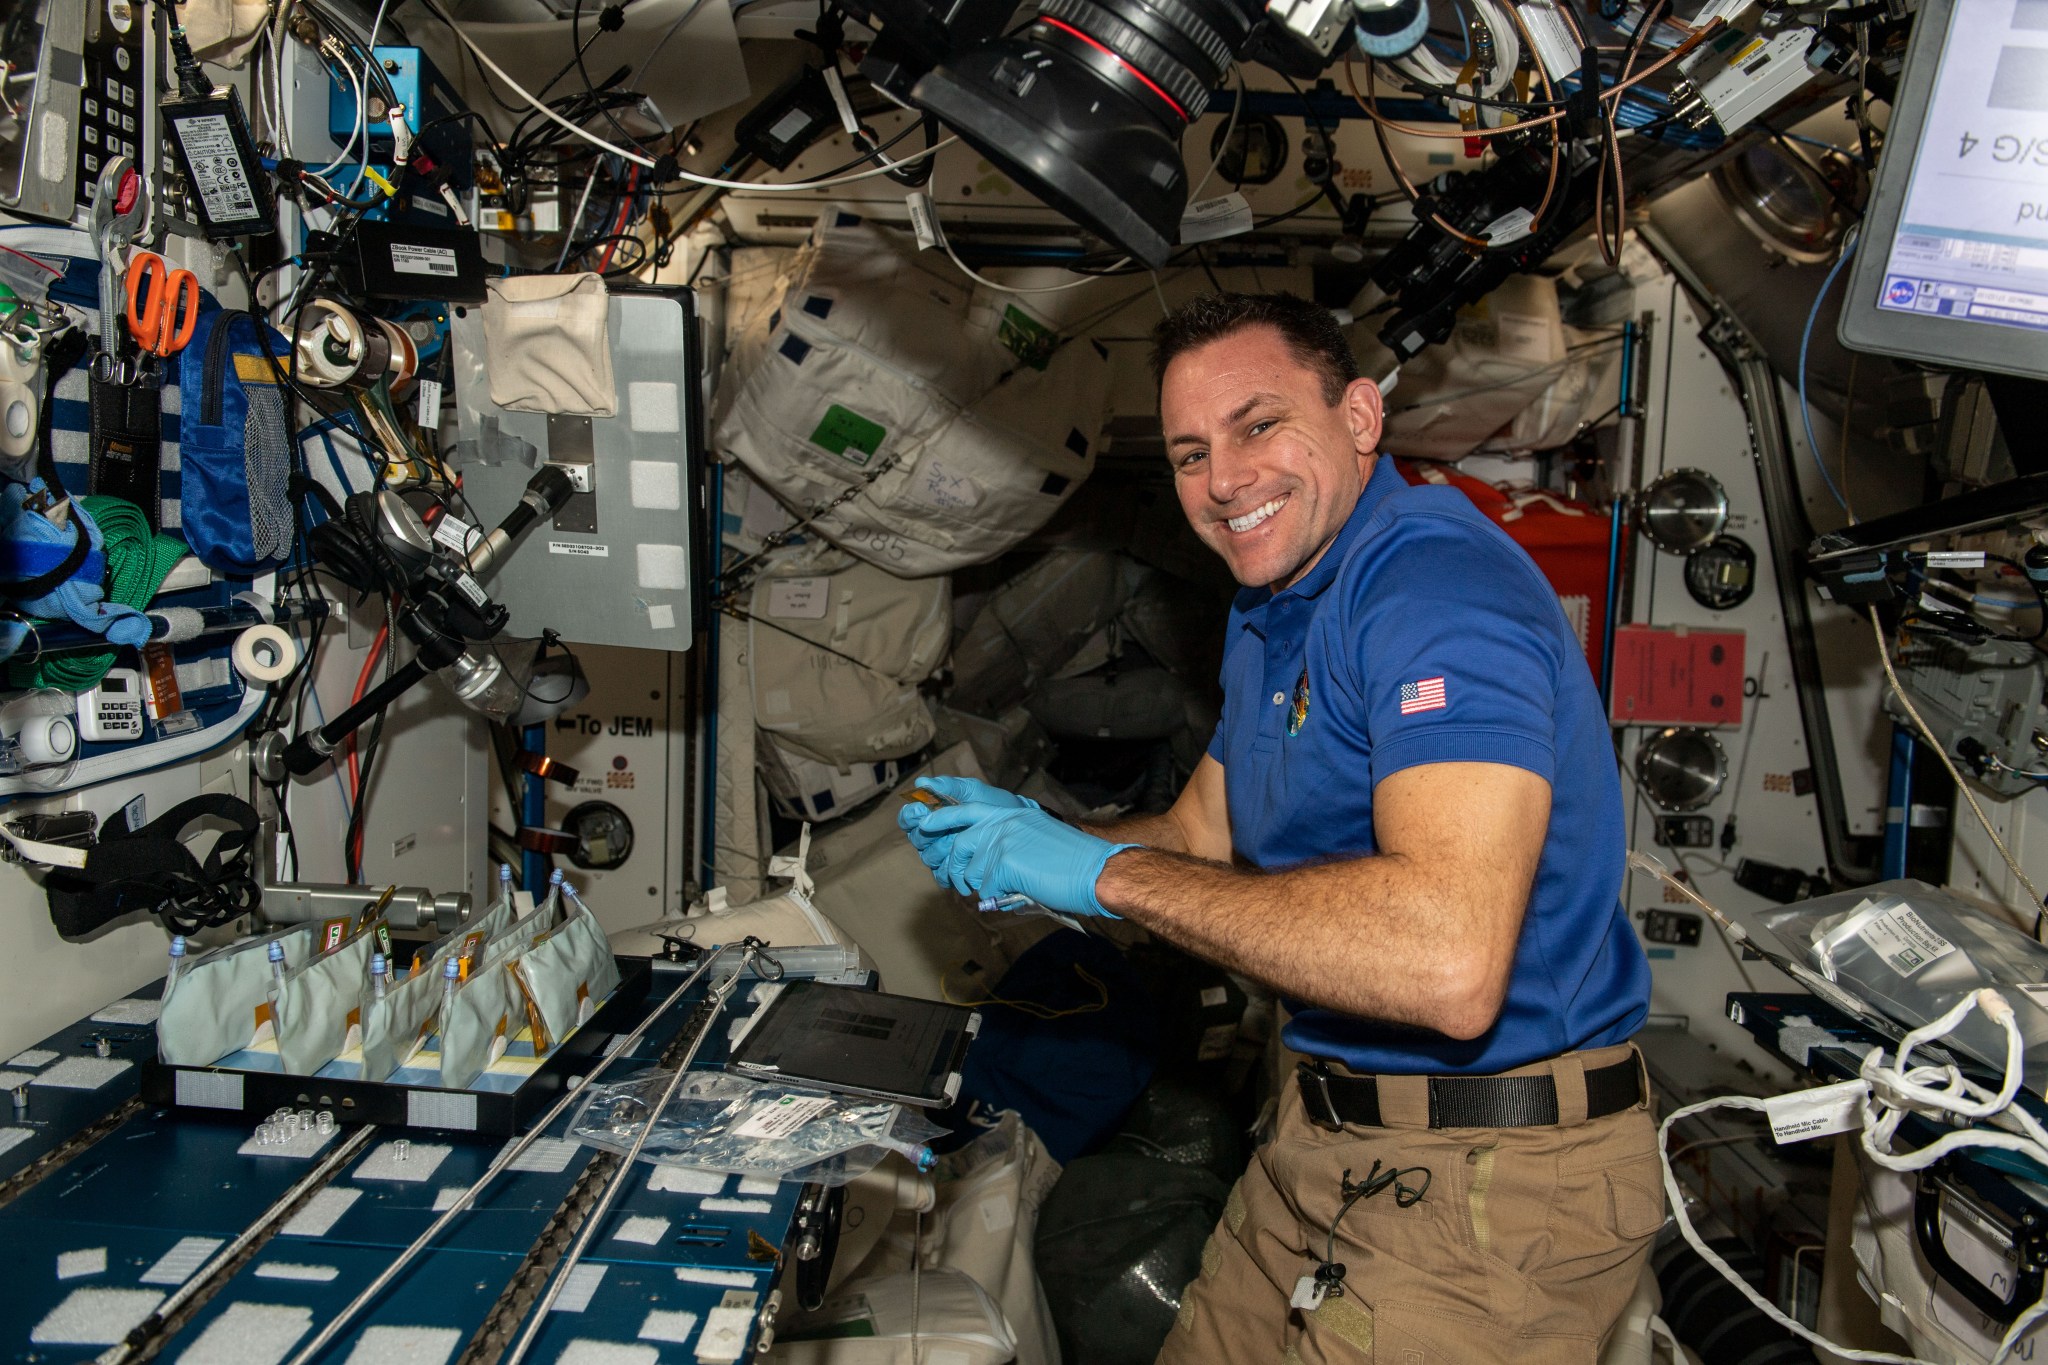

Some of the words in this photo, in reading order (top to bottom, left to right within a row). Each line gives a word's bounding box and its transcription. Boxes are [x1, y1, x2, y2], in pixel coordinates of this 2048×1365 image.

[1959, 131, 1979, 158] 4
[576, 714, 602, 736] To
[608, 716, 653, 737] JEM
[1897, 915, 1924, 943] Production
[1922, 939, 1933, 950] Bag
[1774, 1123, 1801, 1132] Handheld
[1812, 1117, 1829, 1125] Cable
[1783, 1127, 1811, 1136] Handheld
